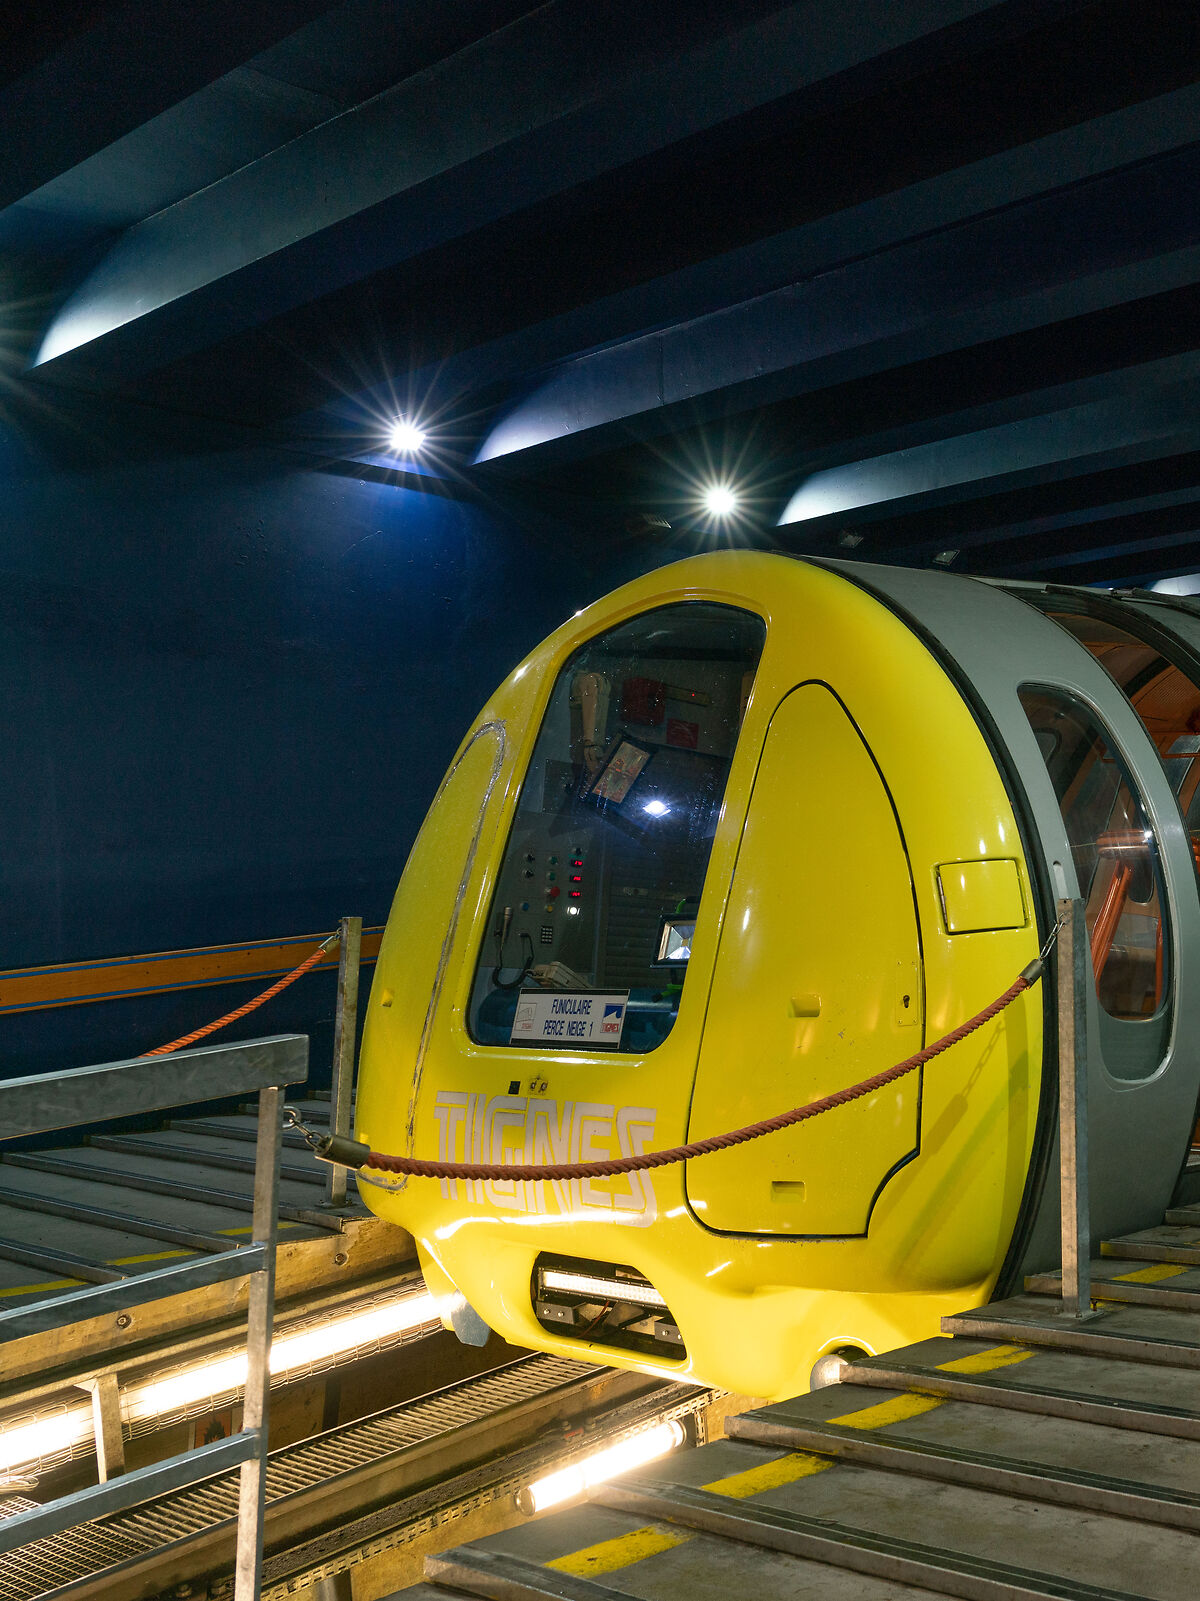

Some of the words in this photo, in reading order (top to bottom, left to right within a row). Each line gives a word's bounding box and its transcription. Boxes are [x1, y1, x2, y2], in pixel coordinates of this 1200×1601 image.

[551, 999, 593, 1015] FUNICULAIRE
[543, 1020, 565, 1036] PERCE
[567, 1021, 587, 1037] NEIGE
[589, 1022, 593, 1037] 1
[433, 1090, 658, 1229] TIGNES
